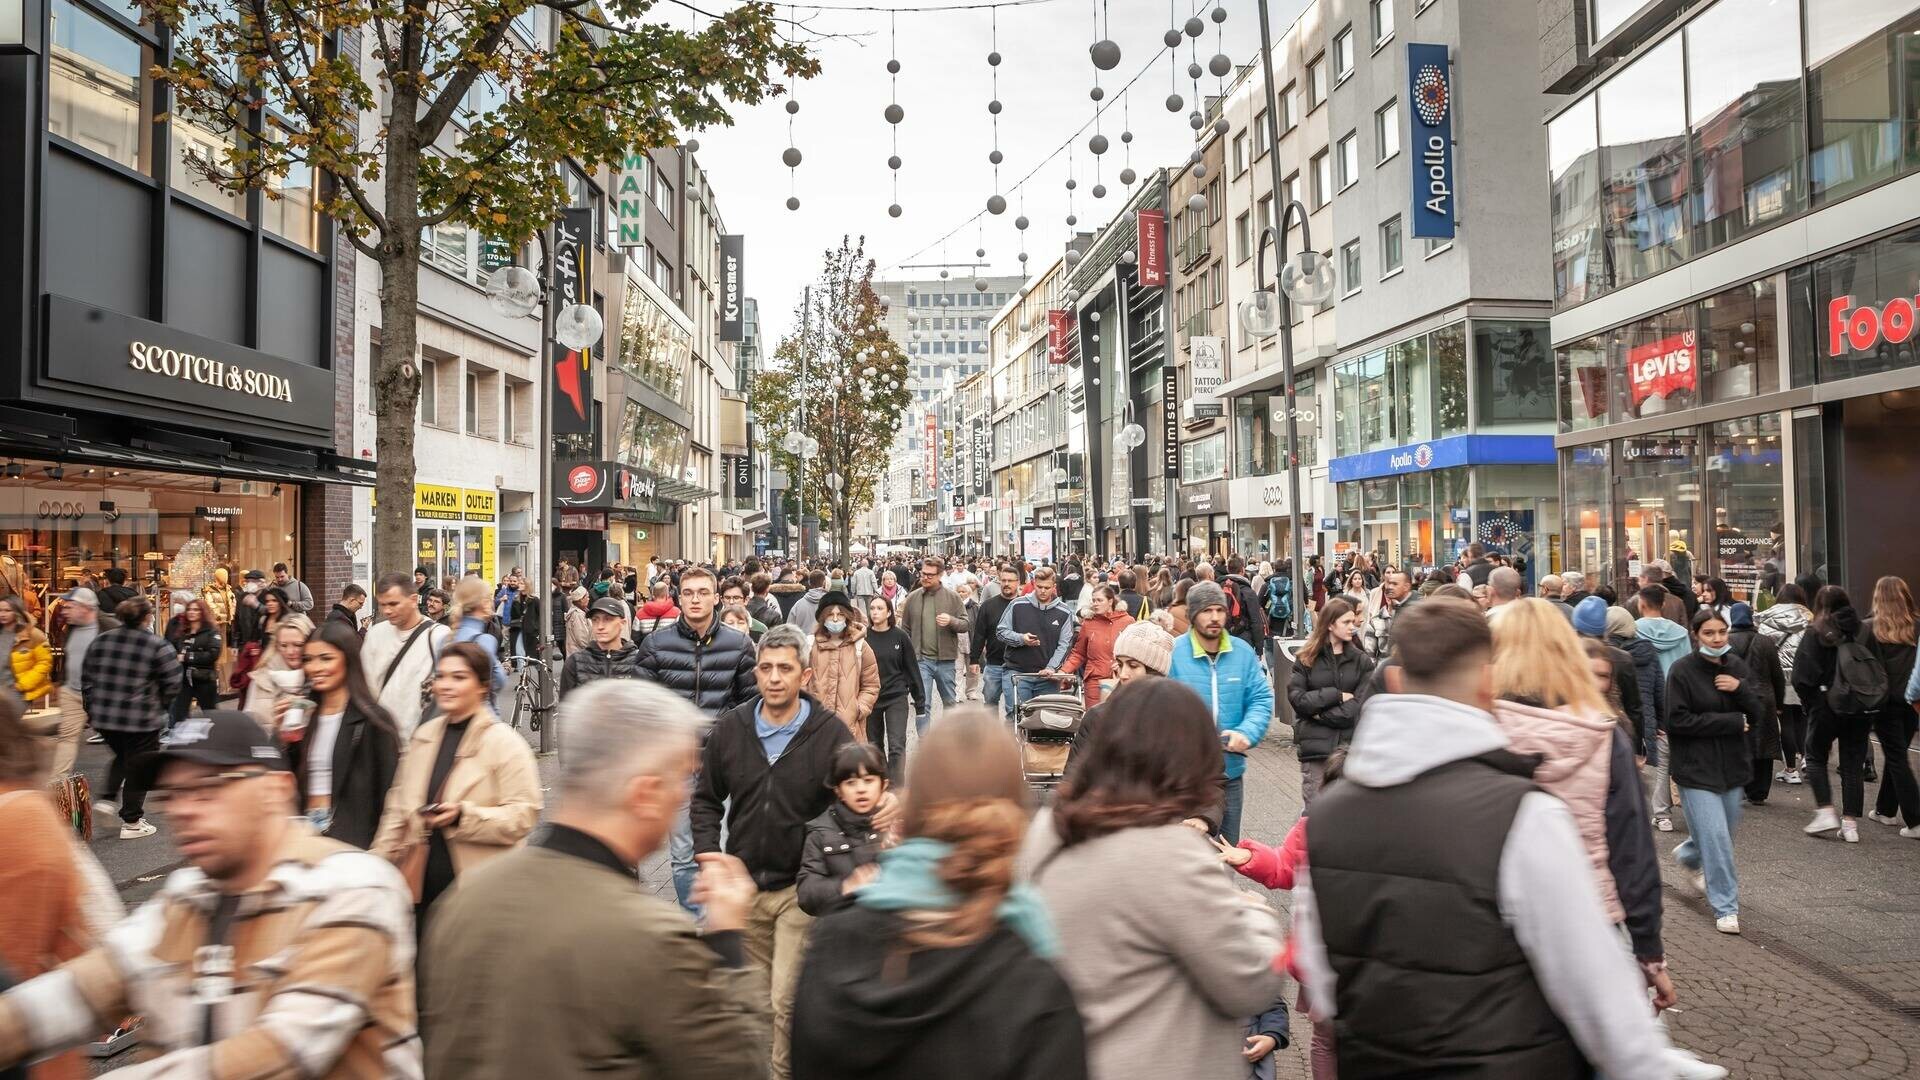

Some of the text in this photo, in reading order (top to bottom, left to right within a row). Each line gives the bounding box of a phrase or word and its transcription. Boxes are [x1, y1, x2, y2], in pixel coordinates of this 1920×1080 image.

[1424, 136, 1450, 215] Apollo
[1147, 223, 1157, 266] fitness first
[725, 256, 738, 322] Kraemer
[1829, 293, 1920, 357] Foo
[130, 341, 293, 403] SCOTCH & SODA
[1194, 377, 1222, 386] TATTOO
[1194, 386, 1215, 394] PIERCI
[1166, 375, 1177, 470] intimissimi
[1273, 410, 1315, 423] eco
[739, 457, 748, 485] ONLY
[974, 427, 984, 487] CALZEDONIA
[1390, 454, 1413, 470] Apollo
[421, 490, 493, 510] MARKEN OUTLET
[1719, 547, 1737, 555] SHOP
[1720, 537, 1773, 546] SECOND CHANCE
